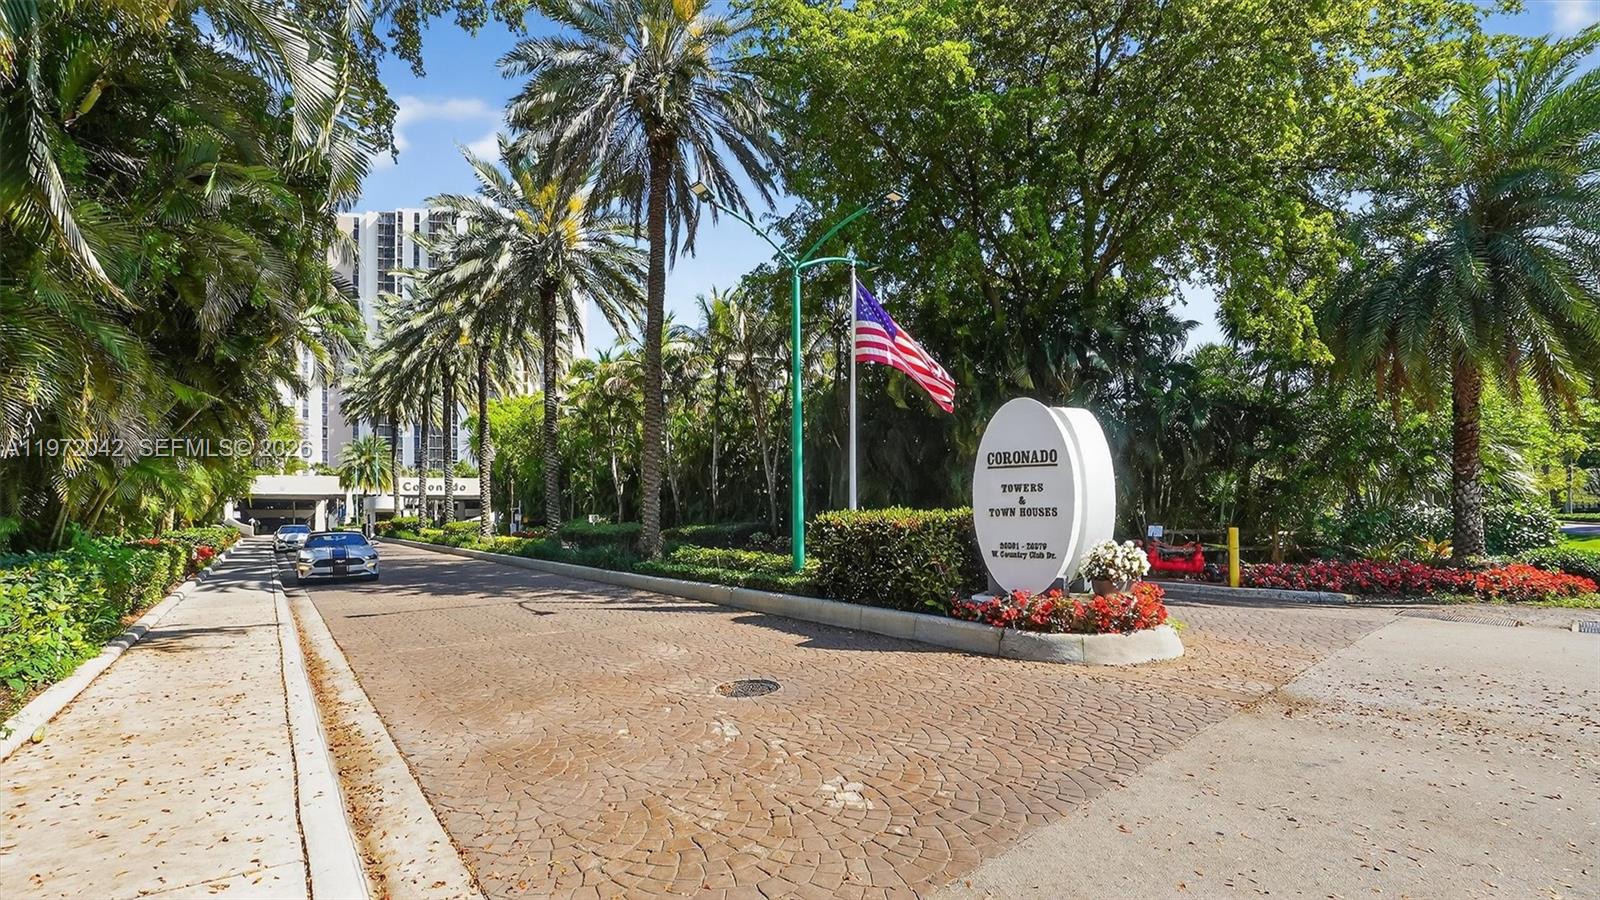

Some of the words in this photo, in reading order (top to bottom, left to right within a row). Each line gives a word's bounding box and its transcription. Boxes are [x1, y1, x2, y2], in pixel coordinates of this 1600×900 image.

[987, 448, 1058, 465] CORONADO
[402, 482, 466, 491] Coondo
[1001, 483, 1044, 493] TOWERS
[1019, 496, 1026, 505] &
[989, 507, 1016, 517] TOWN
[1019, 507, 1058, 517] HOUSES
[1000, 551, 1028, 560] Country
[1029, 551, 1045, 559] Club
[1046, 551, 1057, 560] Dr.
